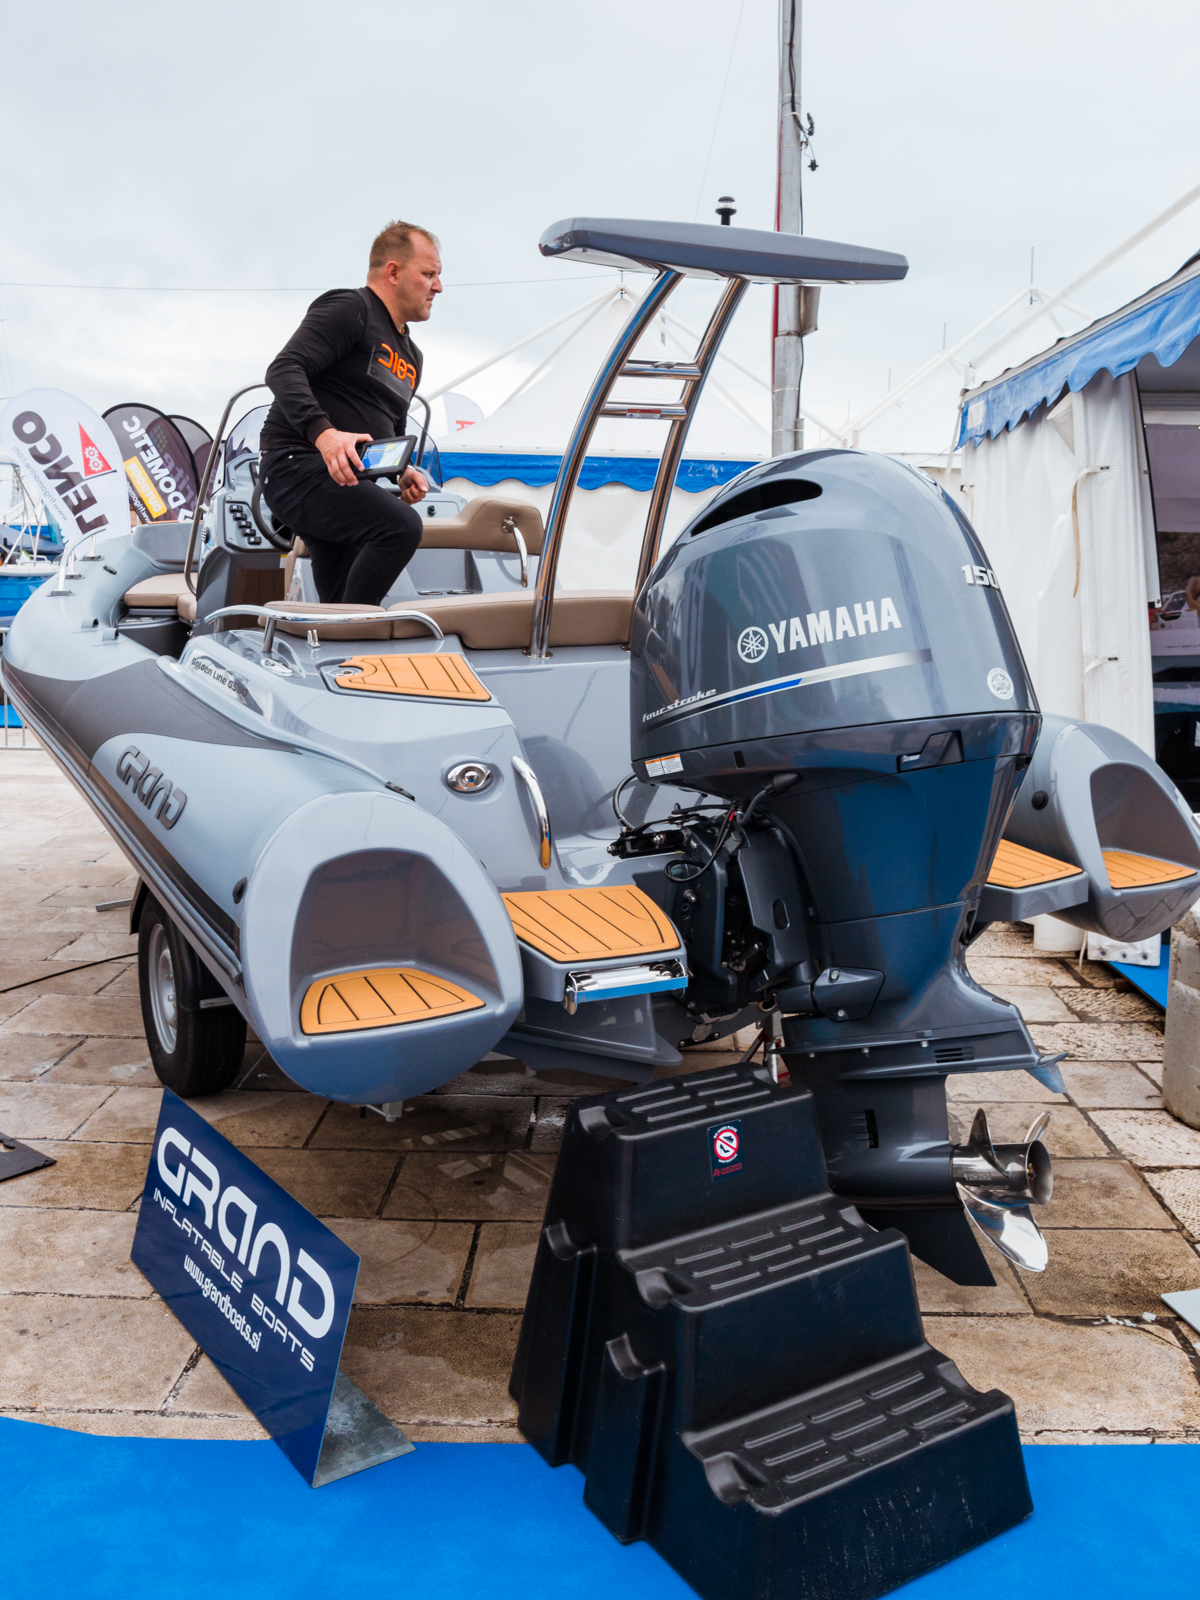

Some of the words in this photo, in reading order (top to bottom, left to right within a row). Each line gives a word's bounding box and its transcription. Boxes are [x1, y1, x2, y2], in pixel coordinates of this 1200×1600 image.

[961, 564, 1001, 590] 150
[767, 596, 903, 654] YAMAHA
[115, 744, 188, 830] GRAND
[156, 1126, 336, 1340] GRAND
[153, 1187, 244, 1294] INFLATABLE
[249, 1292, 316, 1373] BOATS
[182, 1254, 262, 1353] www.grandboats.si
